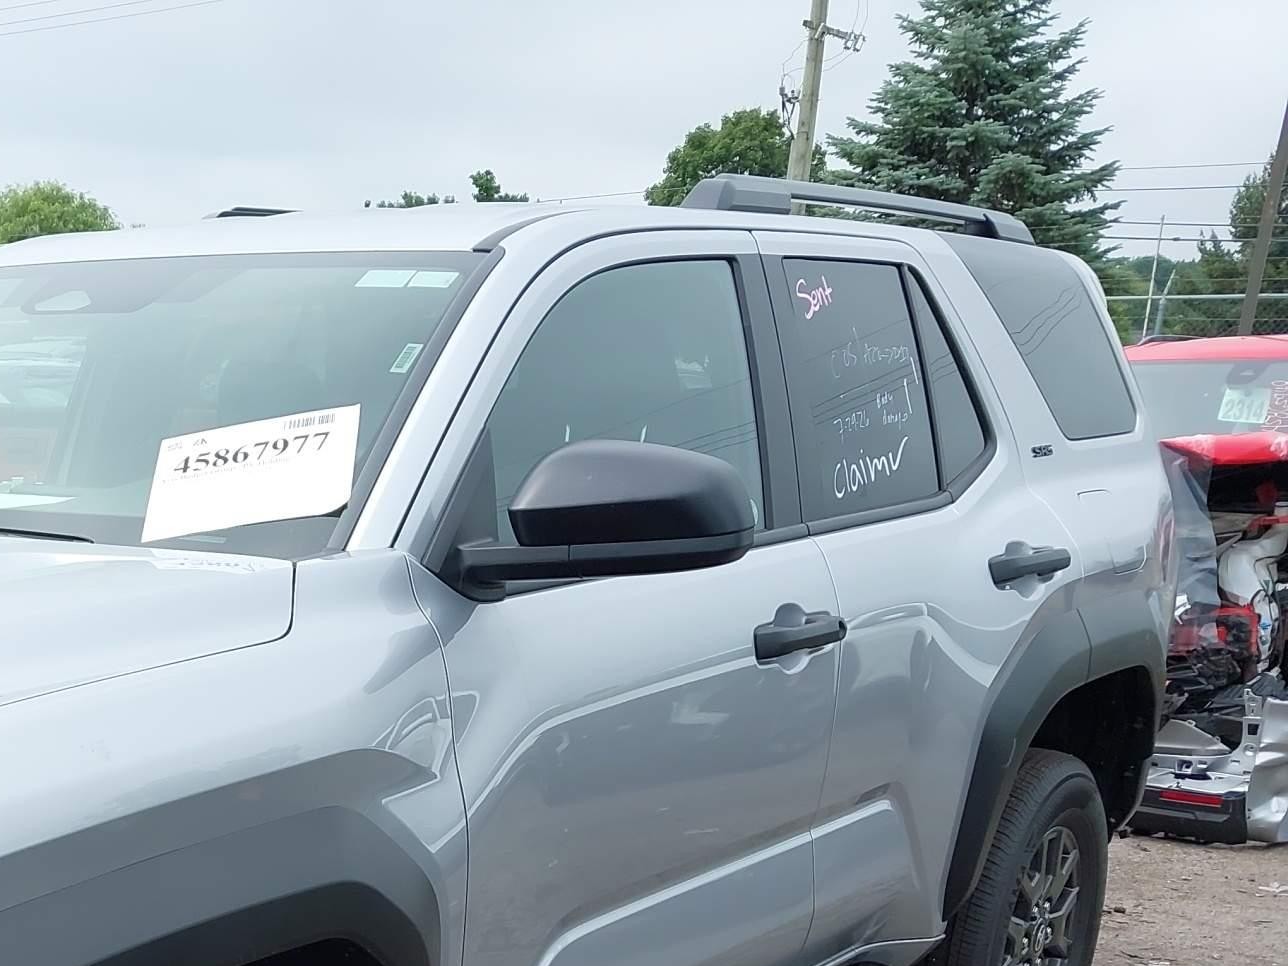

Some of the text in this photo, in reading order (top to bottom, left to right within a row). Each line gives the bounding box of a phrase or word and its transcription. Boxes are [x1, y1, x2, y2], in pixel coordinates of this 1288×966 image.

[796, 276, 833, 319] Sent
[1222, 399, 1265, 421] 2314
[173, 431, 330, 474] 45867977
